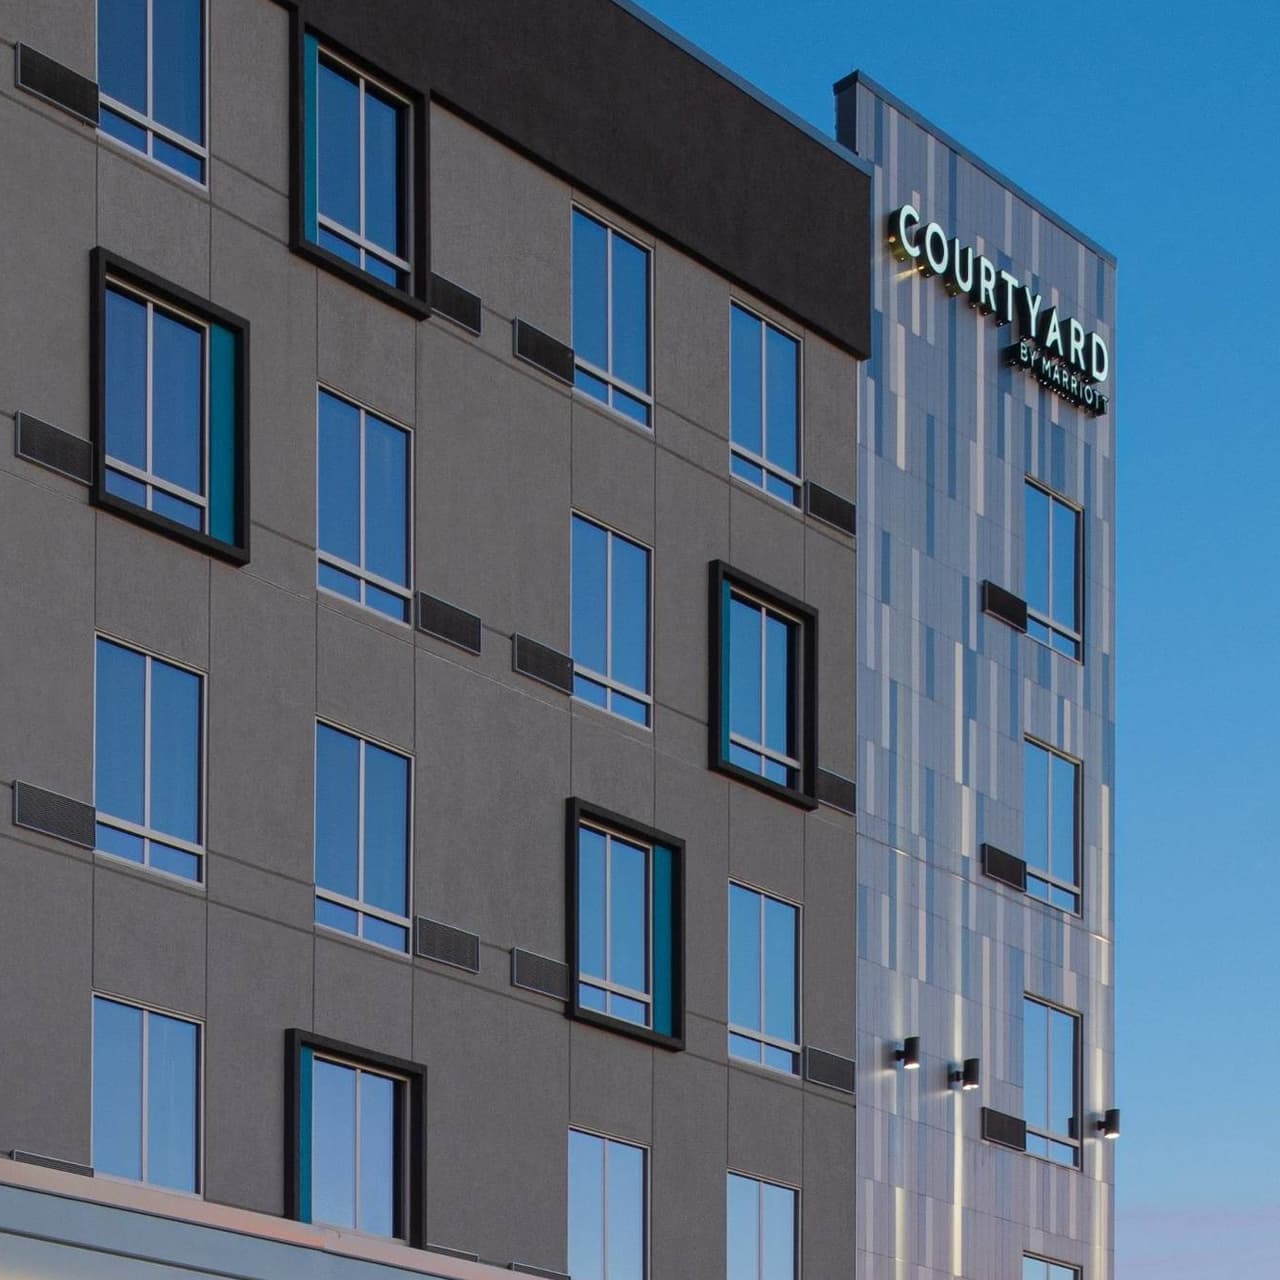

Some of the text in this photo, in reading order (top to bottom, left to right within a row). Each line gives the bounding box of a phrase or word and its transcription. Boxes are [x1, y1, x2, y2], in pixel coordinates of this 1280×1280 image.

[897, 204, 1109, 383] COURTYARD
[1019, 341, 1110, 411] BY MARRIOTT
